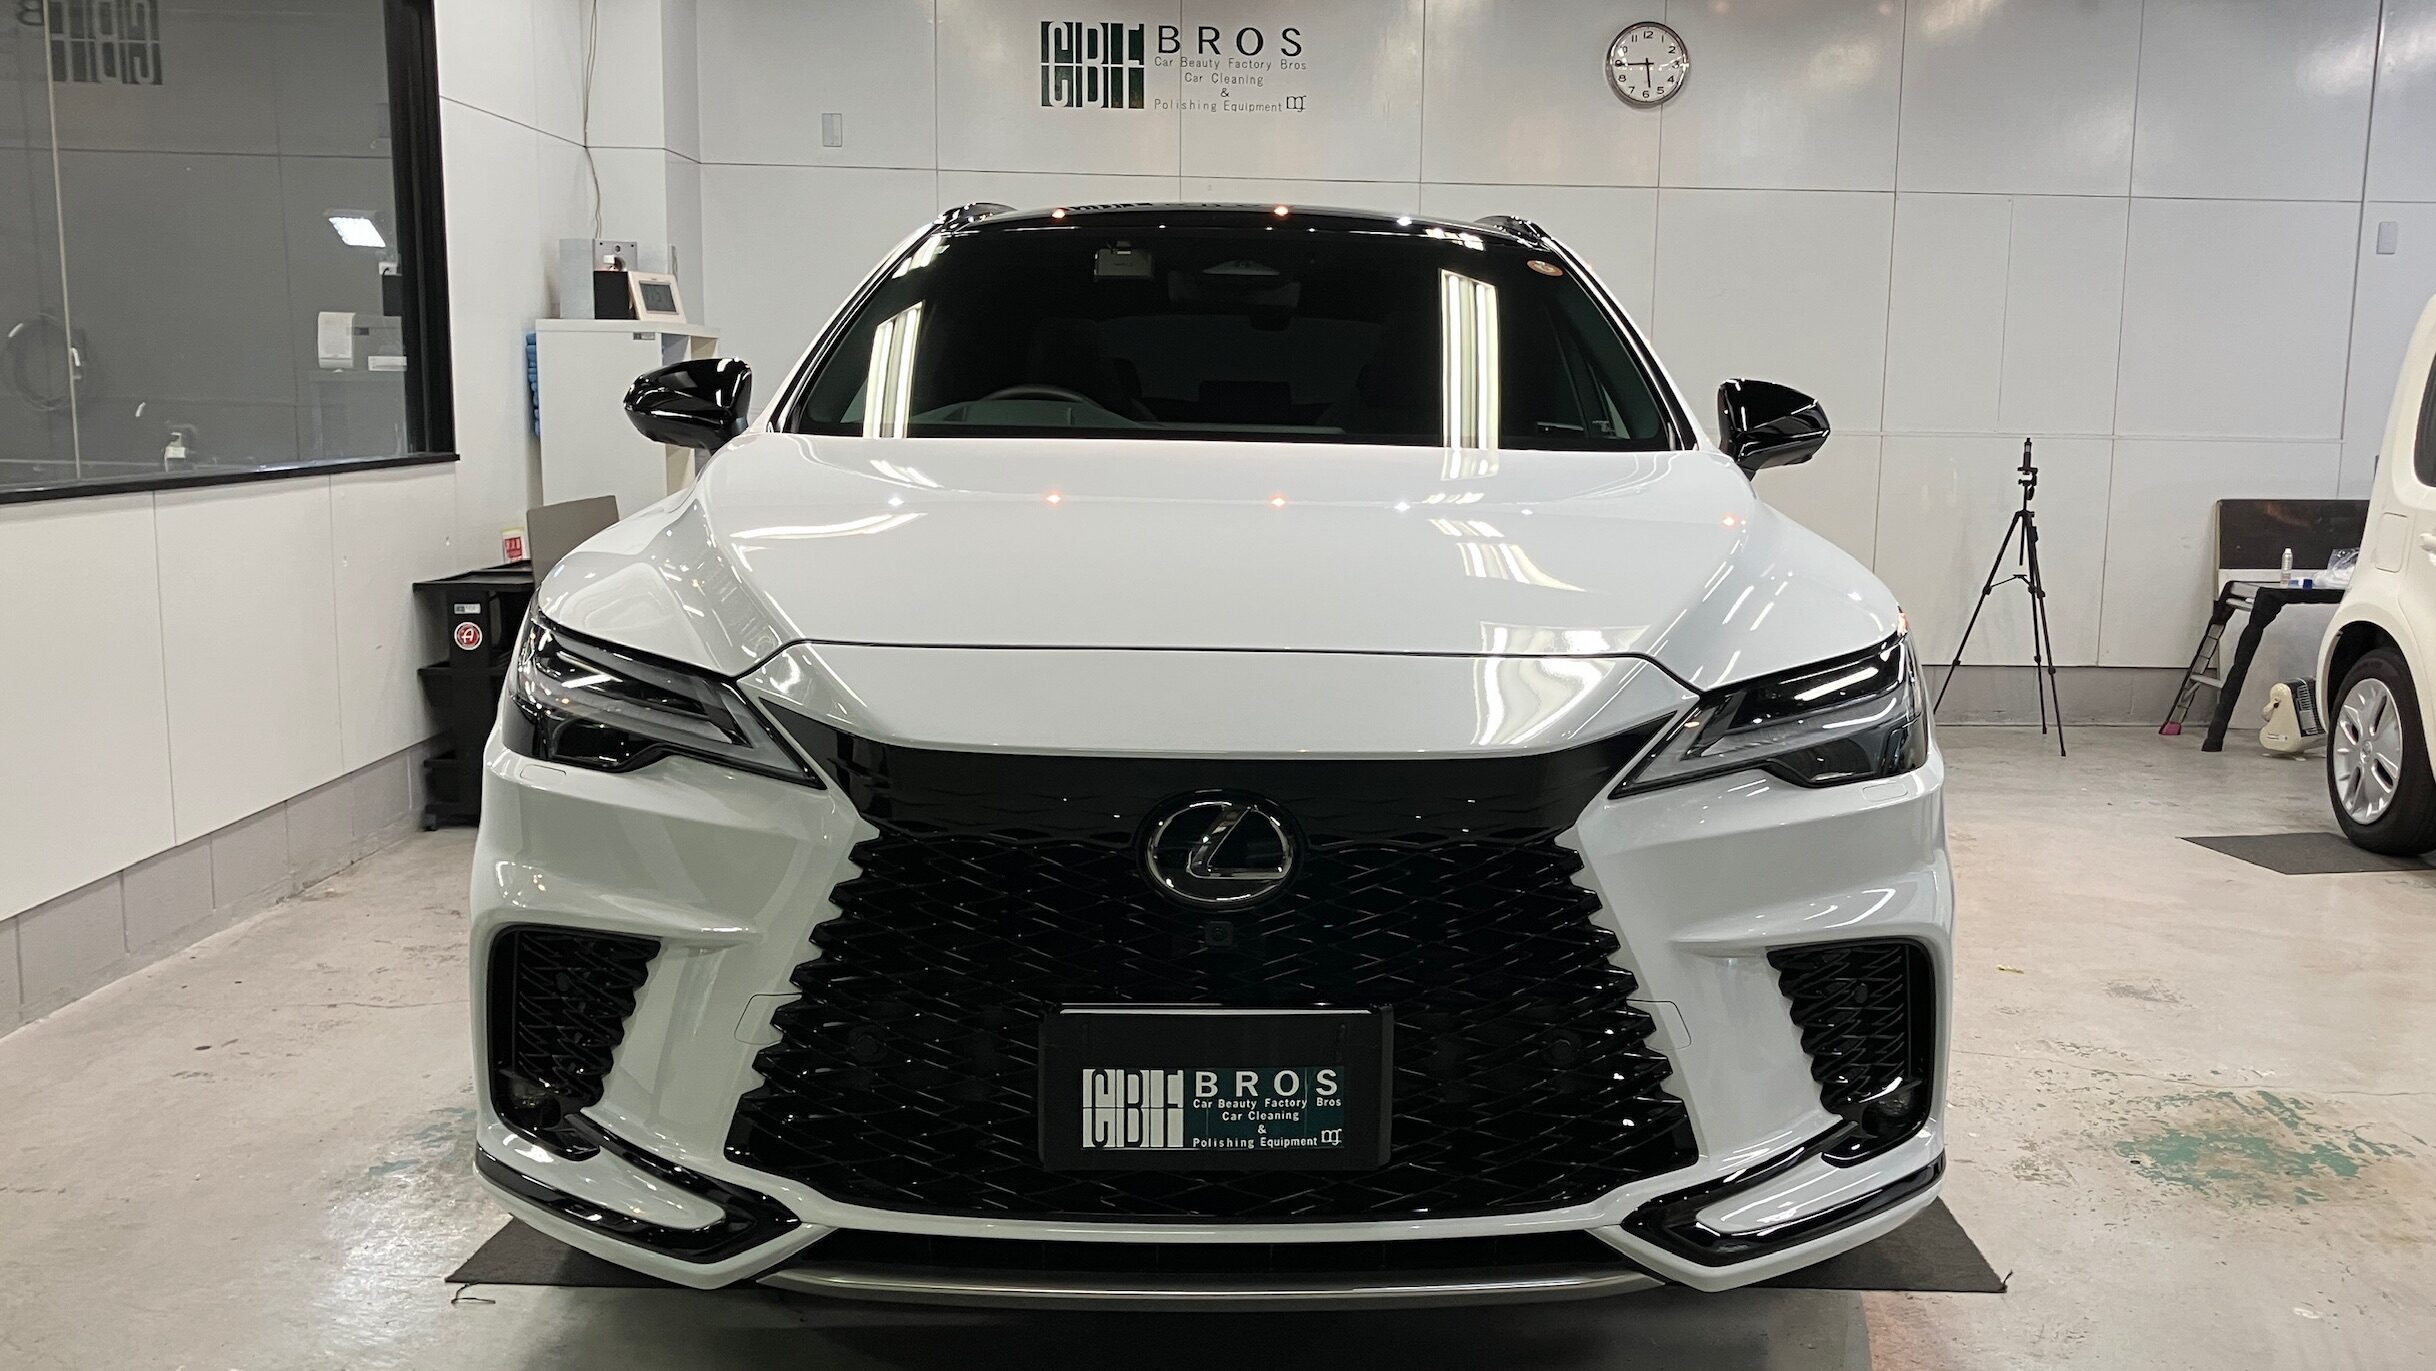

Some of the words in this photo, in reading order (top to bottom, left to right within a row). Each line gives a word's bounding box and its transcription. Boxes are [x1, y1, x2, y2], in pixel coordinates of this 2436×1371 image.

[1631, 34, 1638, 43] 11
[1643, 30, 1654, 39] 12
[1158, 25, 1302, 57] BROS
[1668, 45, 1676, 54] 2
[1154, 56, 1173, 67] Car
[1180, 56, 1220, 70] Beauty
[1228, 57, 1272, 71] Factory
[1280, 58, 1307, 70] Bros
[1671, 60, 1680, 69] 3
[1184, 72, 1203, 83] Car
[1211, 72, 1264, 88] Cleaning
[1618, 74, 1627, 82] 8
[1667, 75, 1675, 83] 4
[1220, 87, 1229, 98] &
[1628, 86, 1636, 94] 7
[1642, 90, 1650, 98] 6
[1656, 86, 1665, 94] 5
[1154, 98, 1217, 113] Polishing
[1223, 99, 1283, 112] Equipment
[1195, 1069, 1338, 1098] BROS
[1193, 1098, 1213, 1109] Car
[1218, 1098, 1257, 1110] Beauty
[1264, 1097, 1307, 1110] Factory
[1316, 1096, 1342, 1107] Bros
[1222, 1111, 1242, 1121] Car
[1248, 1110, 1300, 1122] Cleaning
[1257, 1124, 1267, 1135] &
[1193, 1137, 1255, 1149] Polishing
[1260, 1136, 1318, 1149] Equipment
